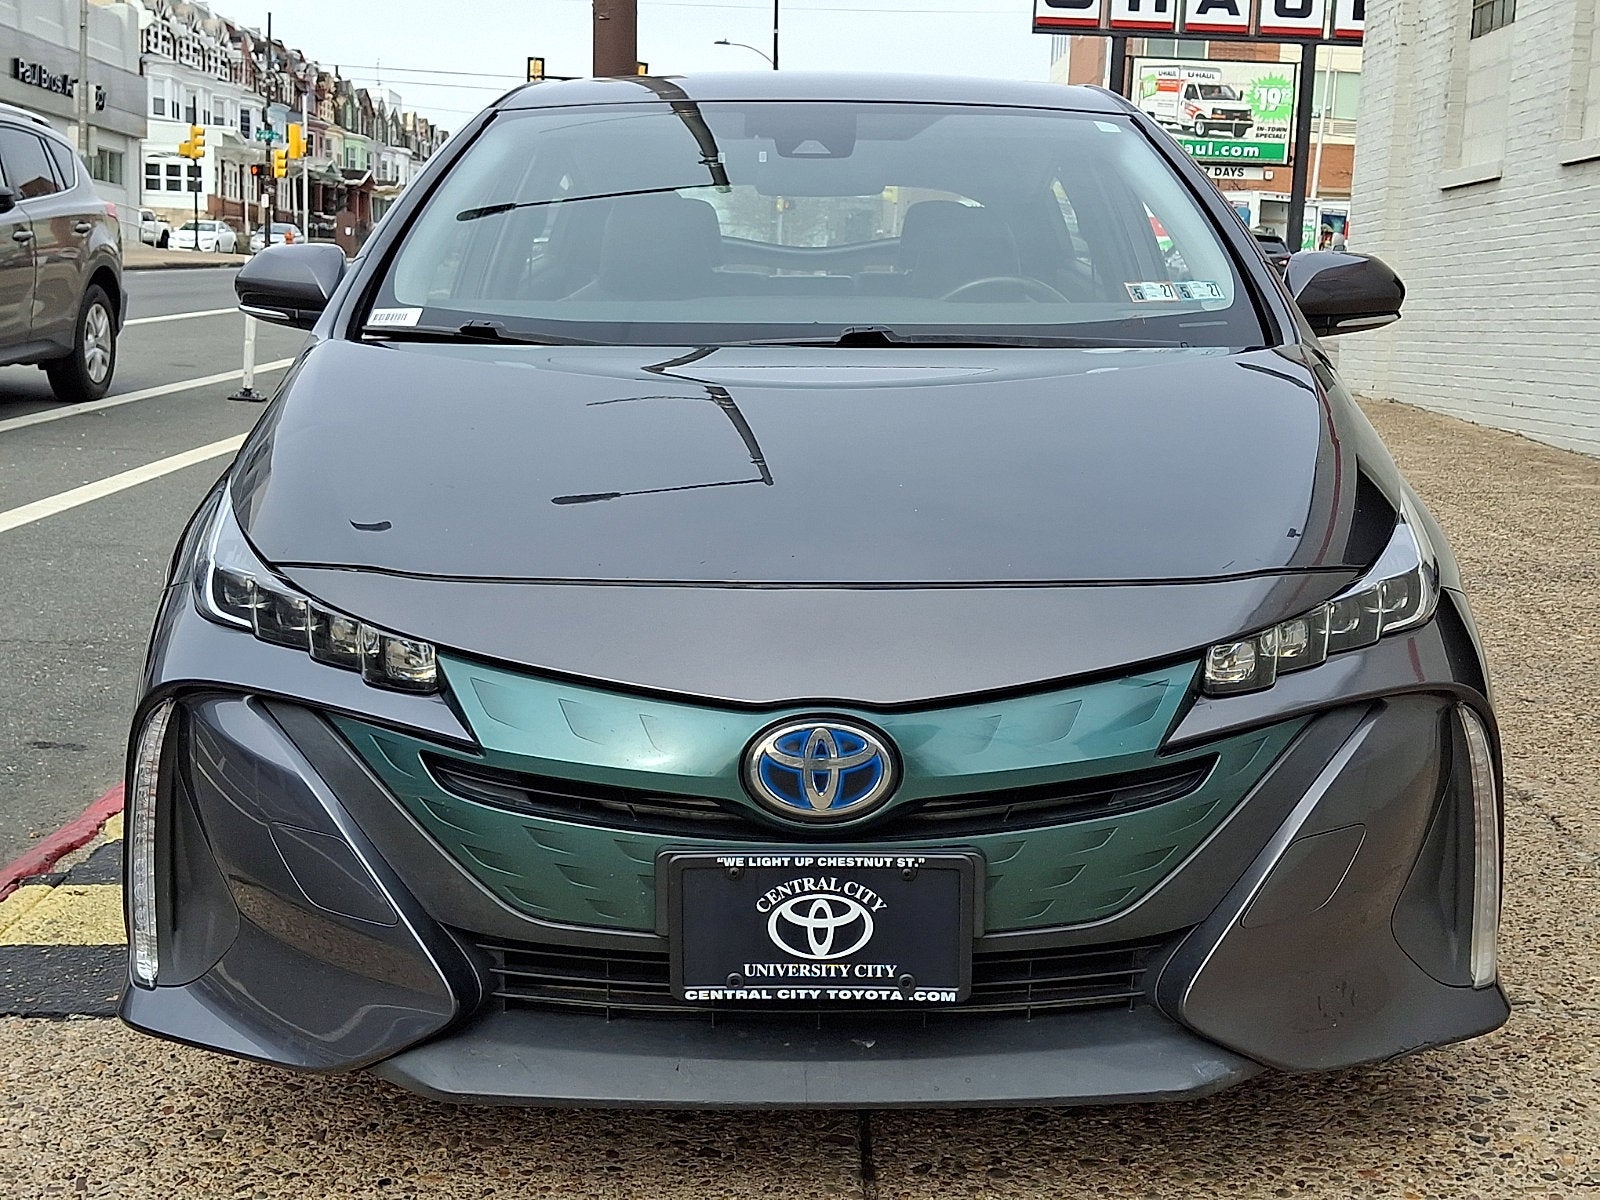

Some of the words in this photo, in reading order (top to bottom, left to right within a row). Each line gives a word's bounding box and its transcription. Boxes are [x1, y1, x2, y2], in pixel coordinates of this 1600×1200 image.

[13, 57, 40, 85] Paul
[1184, 141, 1260, 157] aul.com
[1214, 167, 1245, 177] DAYS
[1134, 288, 1145, 300] 5
[1160, 284, 1174, 298] 27
[1180, 286, 1191, 299] 5
[1206, 283, 1221, 297] 27
[748, 857, 791, 867] LIGHT
[794, 857, 814, 867] UP
[817, 857, 893, 868] CHESTNUT
[756, 876, 842, 913] CENTRAL
[843, 881, 888, 913] CITY
[743, 963, 851, 978] UNIVERSITY
[854, 964, 898, 978] CITY
[684, 989, 773, 1000] CENTRAL
[776, 989, 821, 1000] CITY
[826, 989, 904, 1001] TOYOTA
[908, 991, 956, 1002] .COM
